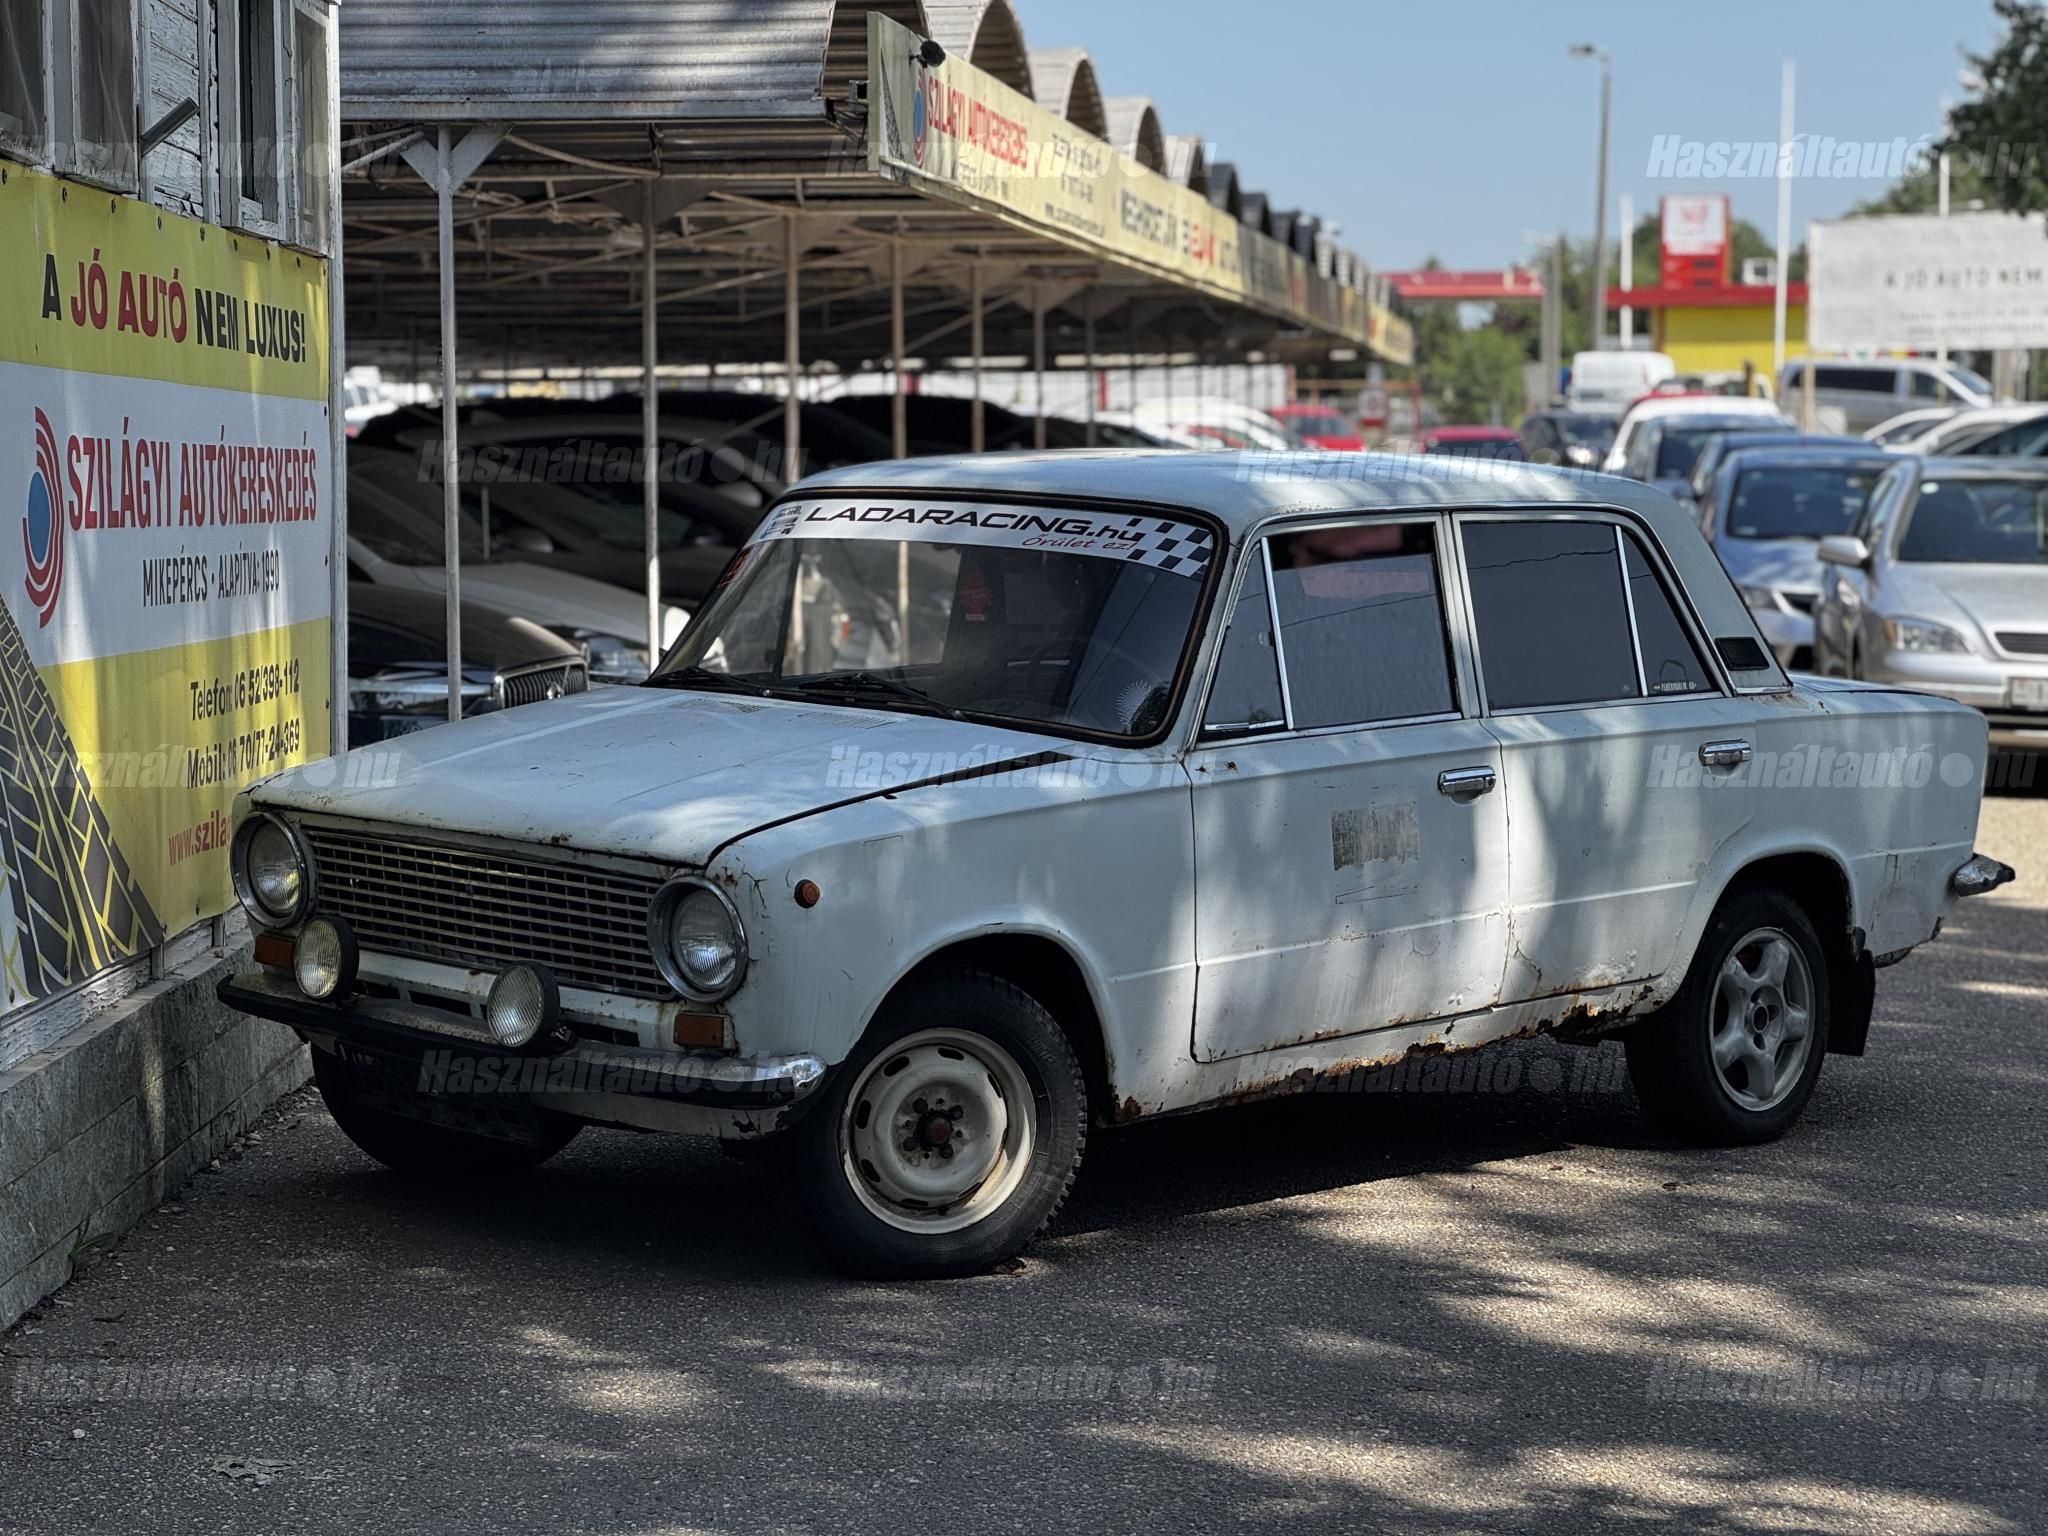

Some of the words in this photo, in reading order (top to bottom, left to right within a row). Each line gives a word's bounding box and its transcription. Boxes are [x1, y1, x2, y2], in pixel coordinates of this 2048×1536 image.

[42, 253, 62, 320] A
[71, 248, 108, 330] JÓ
[118, 268, 188, 343] AUTÓ
[195, 288, 240, 351] NEM
[244, 301, 306, 363] LUXUS!
[67, 416, 171, 531] SZILÁGYI
[178, 424, 317, 528] AUTÓKERESKEDÉS
[804, 506, 1147, 541] LADARACING.hu
[142, 544, 208, 607] MIKEPÉRCS
[218, 541, 260, 599] ALAPÍTVA:
[261, 548, 280, 593] 1990
[190, 677, 233, 721] Telefon:
[248, 658, 300, 706] 52/398-112
[187, 743, 226, 790] Mobil:
